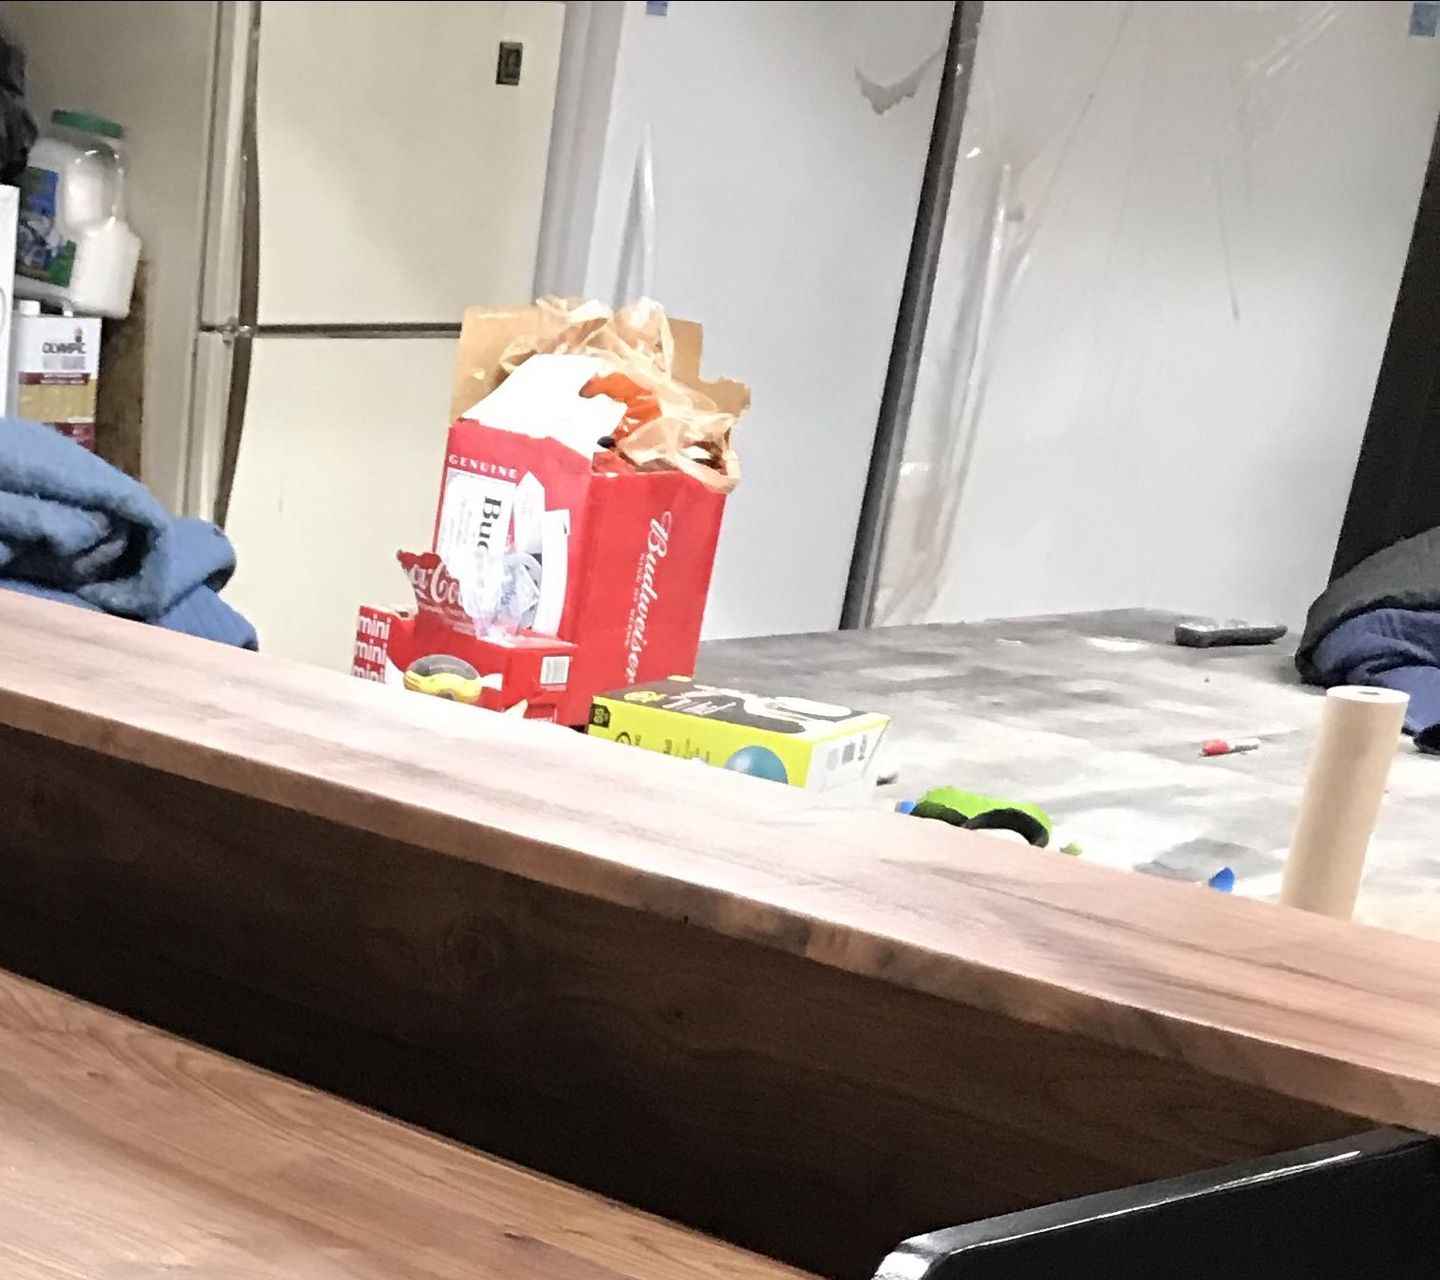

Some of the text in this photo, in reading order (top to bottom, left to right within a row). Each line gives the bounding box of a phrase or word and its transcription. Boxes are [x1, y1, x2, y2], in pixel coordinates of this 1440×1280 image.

[448, 453, 519, 480] GENUINE
[624, 511, 673, 685] Budweiser
[359, 612, 392, 640] mini
[355, 638, 388, 665] mini
